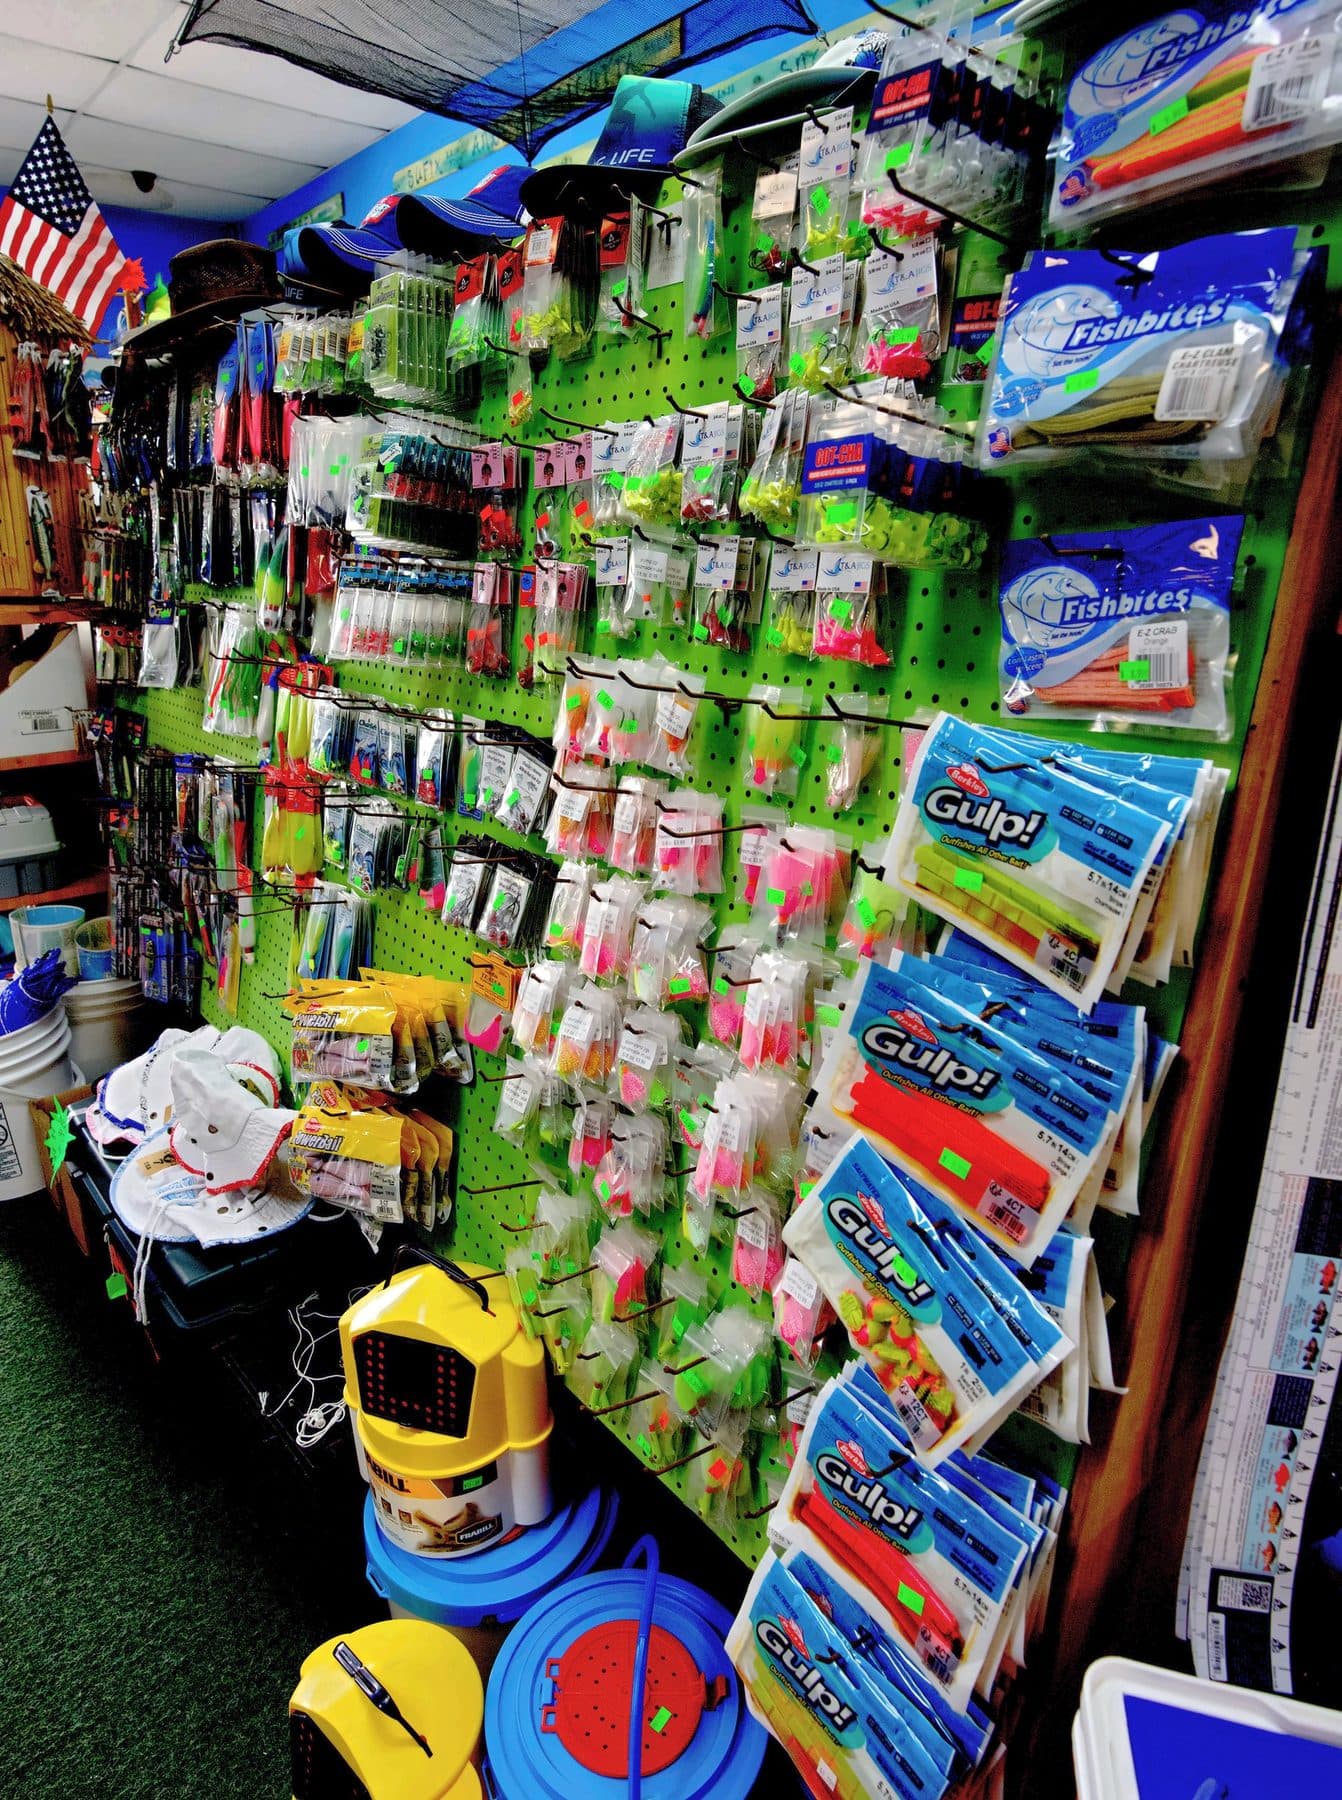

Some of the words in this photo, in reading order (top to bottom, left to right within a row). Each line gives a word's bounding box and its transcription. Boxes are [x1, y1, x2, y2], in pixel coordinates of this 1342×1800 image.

[609, 149, 656, 165] LIFE
[285, 287, 304, 300] LIFE
[1074, 298, 1227, 347] Fishbites
[815, 442, 864, 468] GOT-CHA
[1063, 588, 1191, 622] Fishbites
[1153, 625, 1179, 637] CRAB
[951, 769, 986, 796] Berkley
[925, 788, 1047, 844] Gulp!
[940, 836, 976, 853] Outfishes
[976, 845, 988, 856] All
[987, 848, 1009, 863] Other
[1064, 949, 1081, 965] 4CT
[864, 1026, 999, 1095] Gulp!
[882, 1069, 921, 1093] Outfishes
[920, 1086, 933, 1098] All
[932, 1091, 958, 1108] Other
[1005, 1197, 1025, 1214] 4CT
[864, 1271, 876, 1284] All
[874, 1281, 894, 1305] Other
[910, 1397, 929, 1422] 12CT
[817, 1455, 920, 1538] Gulp!
[459, 1523, 494, 1541] FRABILL
[862, 1519, 873, 1531] All
[934, 1645, 950, 1662] 4CT
[756, 1620, 857, 1727] Gulp!
